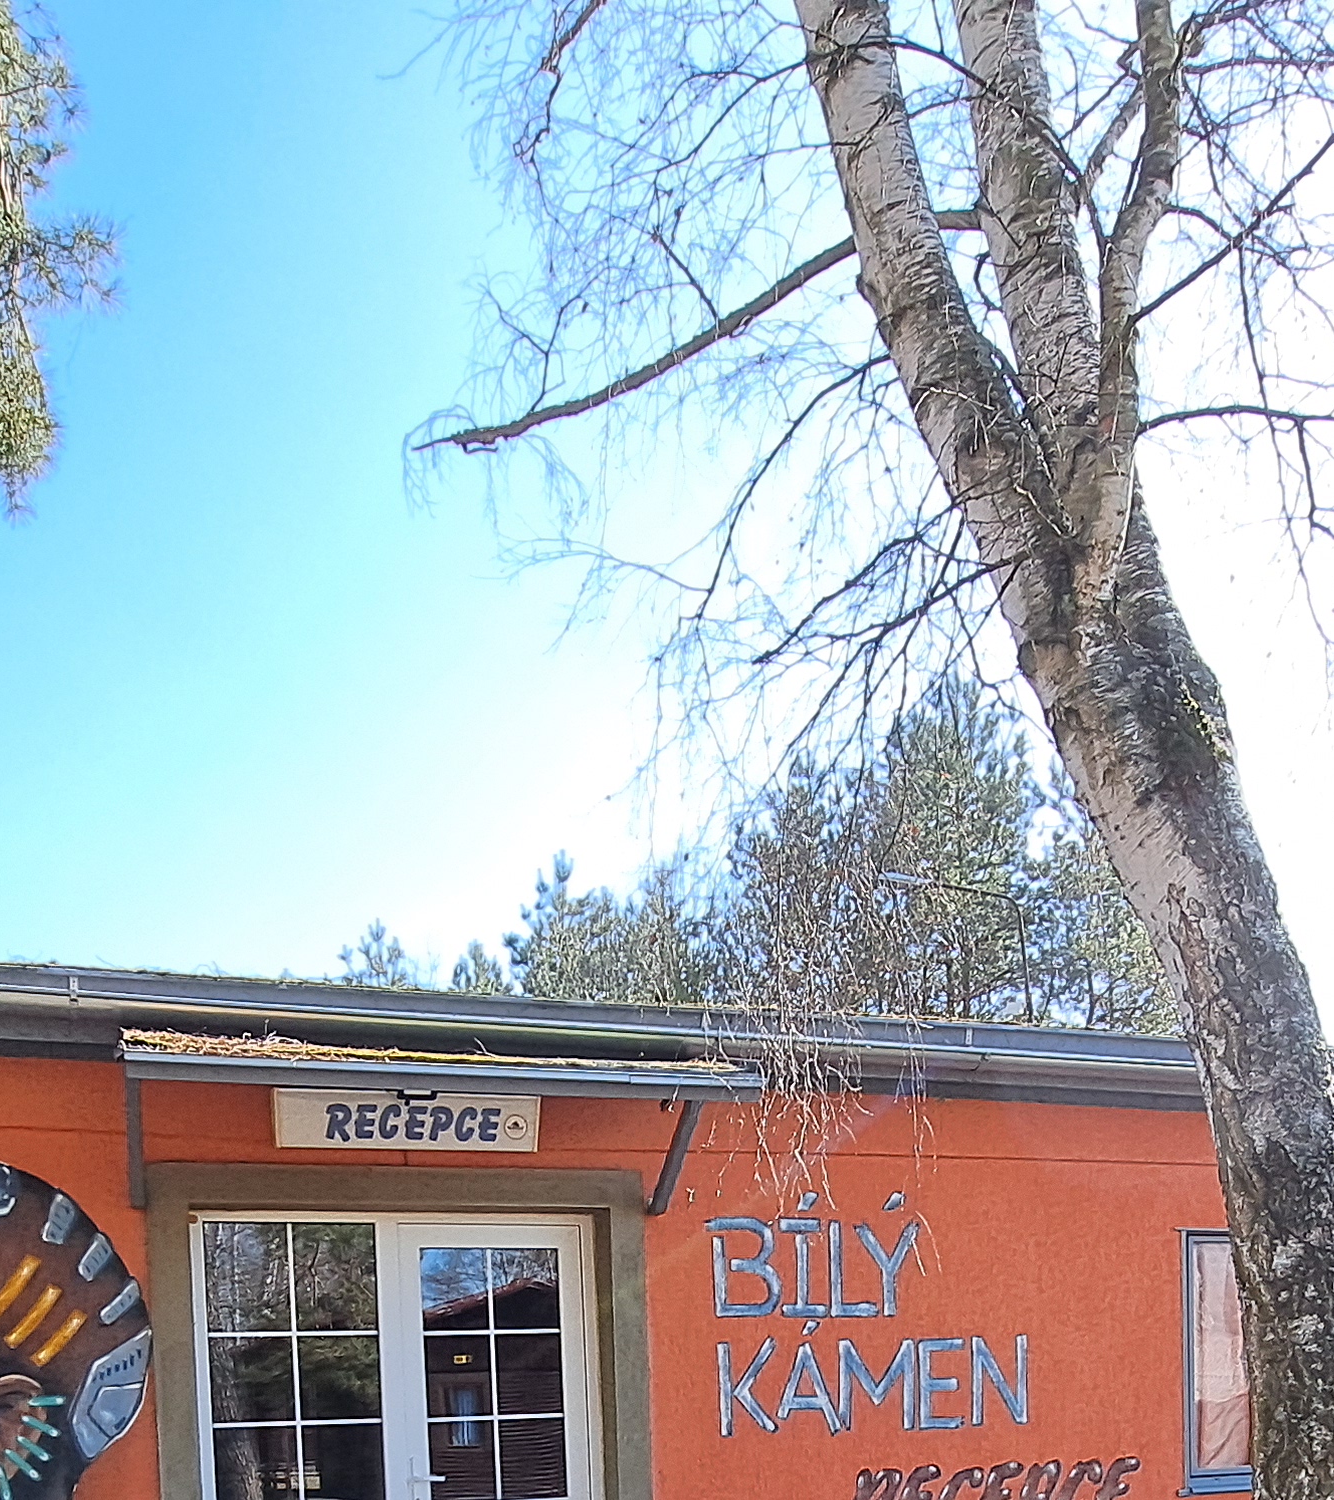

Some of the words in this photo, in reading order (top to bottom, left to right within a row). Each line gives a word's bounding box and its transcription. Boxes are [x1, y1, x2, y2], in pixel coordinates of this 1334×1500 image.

[325, 1103, 501, 1143] RECEPCE
[704, 1190, 919, 1318] BÍLÝ
[716, 1320, 1028, 1437] KÁMEN
